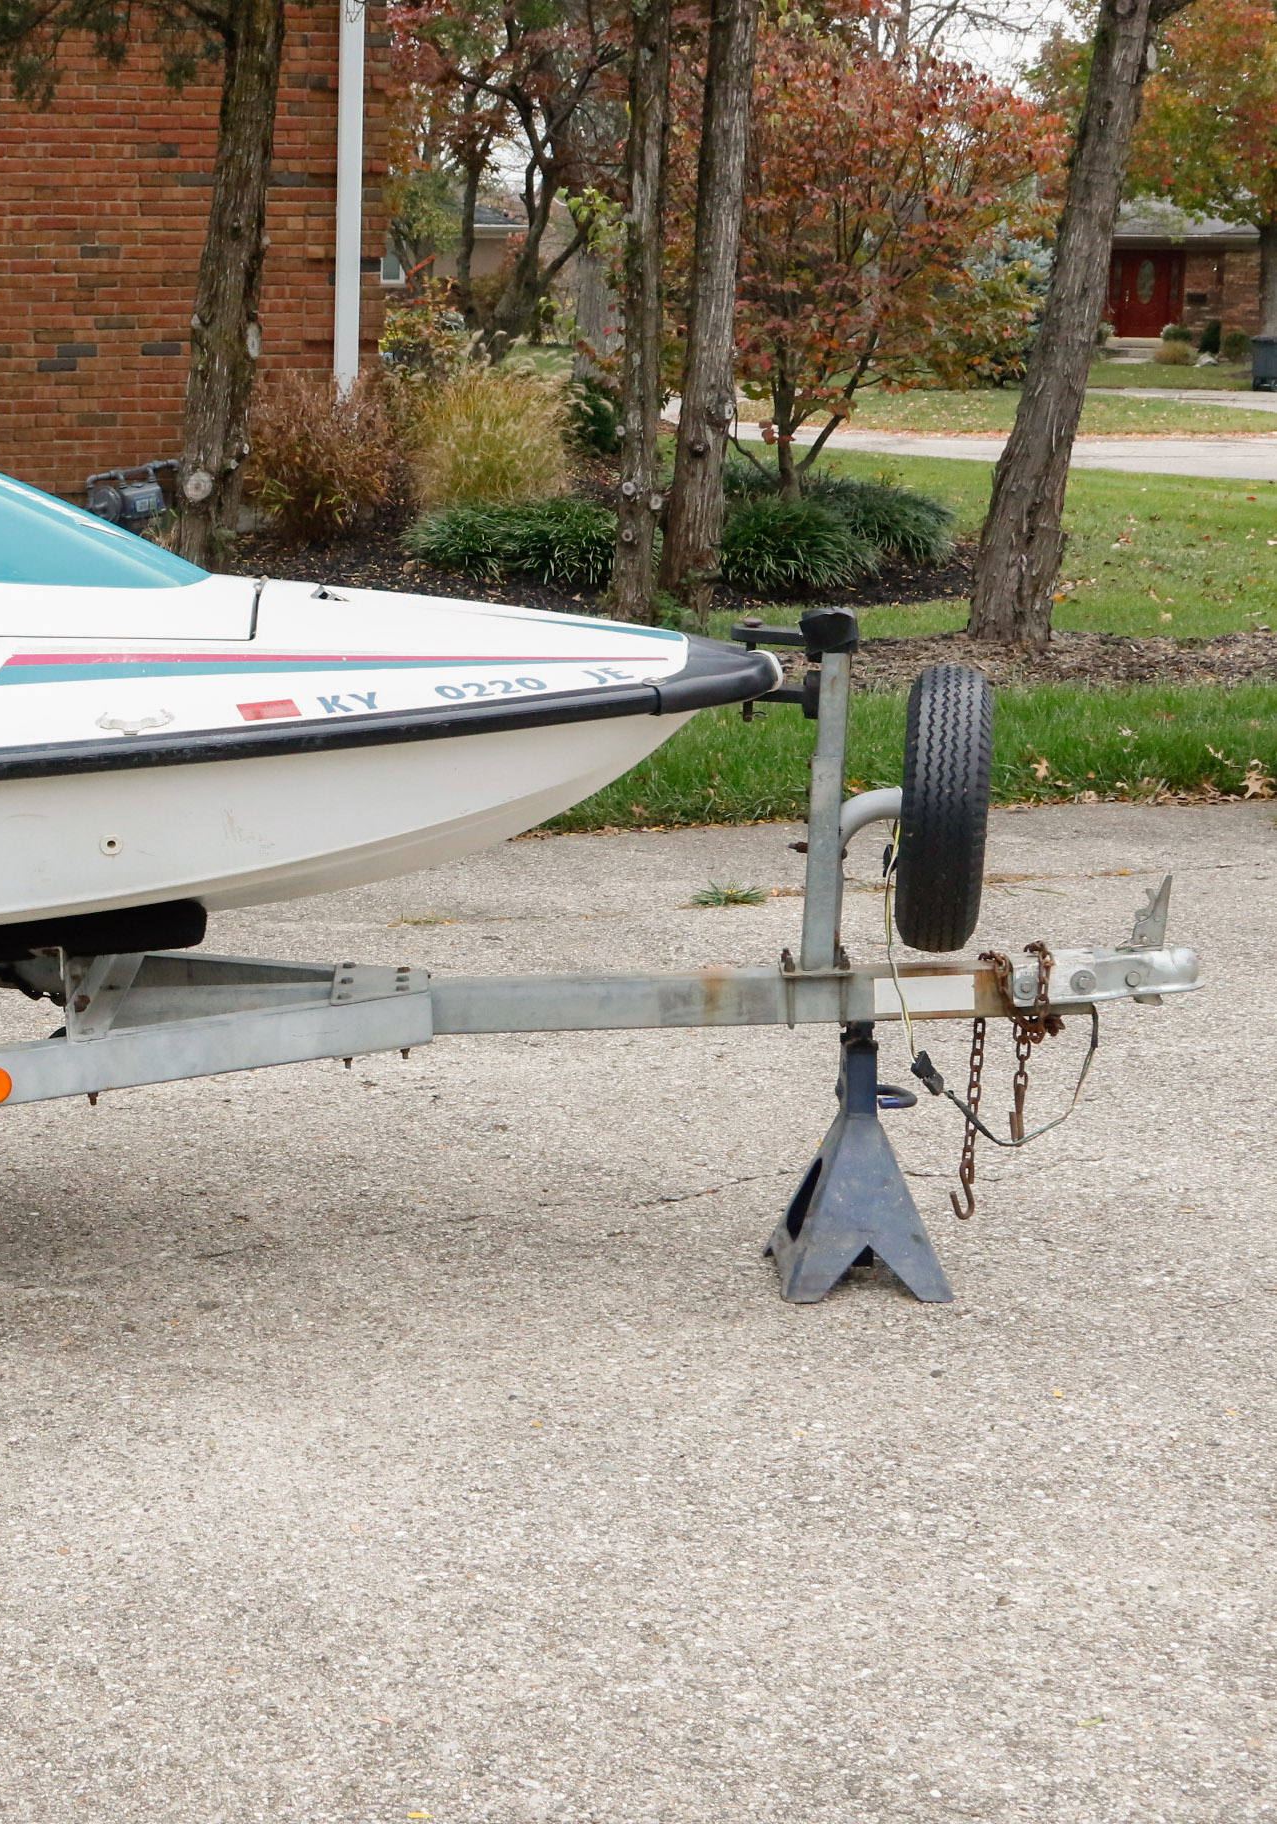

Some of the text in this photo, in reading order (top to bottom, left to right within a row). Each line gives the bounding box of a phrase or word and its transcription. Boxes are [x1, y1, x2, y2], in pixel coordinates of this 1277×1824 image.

[316, 691, 378, 714] KY
[434, 677, 547, 700] 0220
[581, 667, 634, 686] JE
